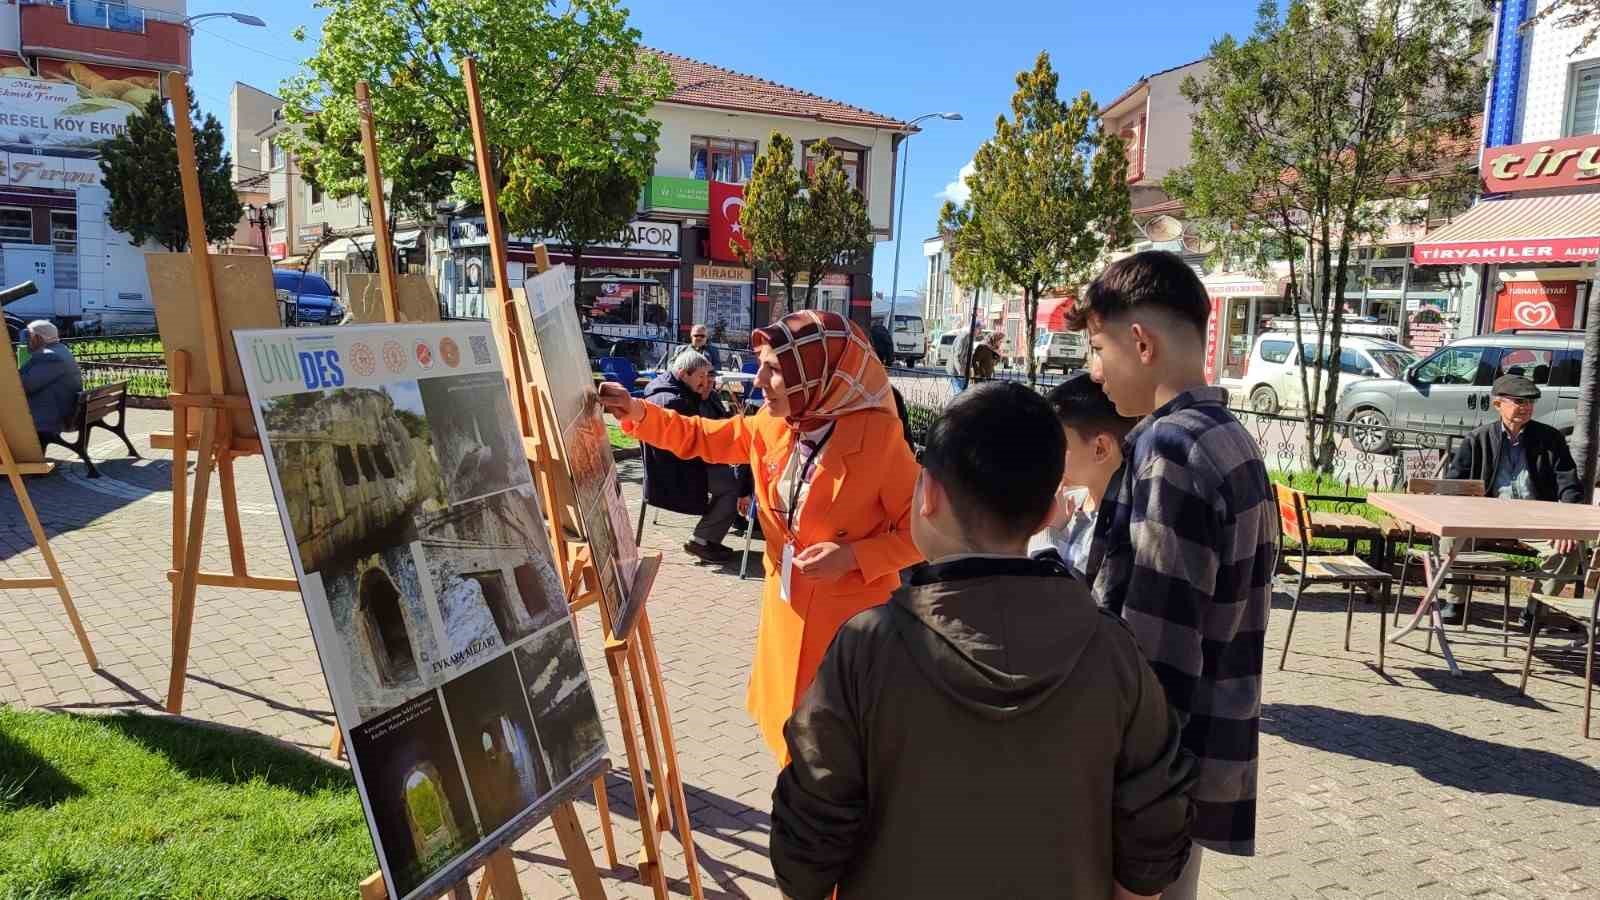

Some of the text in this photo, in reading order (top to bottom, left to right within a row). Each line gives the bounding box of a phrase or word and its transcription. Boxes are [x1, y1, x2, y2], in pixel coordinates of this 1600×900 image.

[54, 116, 85, 134] KÖY
[1420, 245, 1553, 260] TİRYAKİLER
[300, 349, 345, 389] DES
